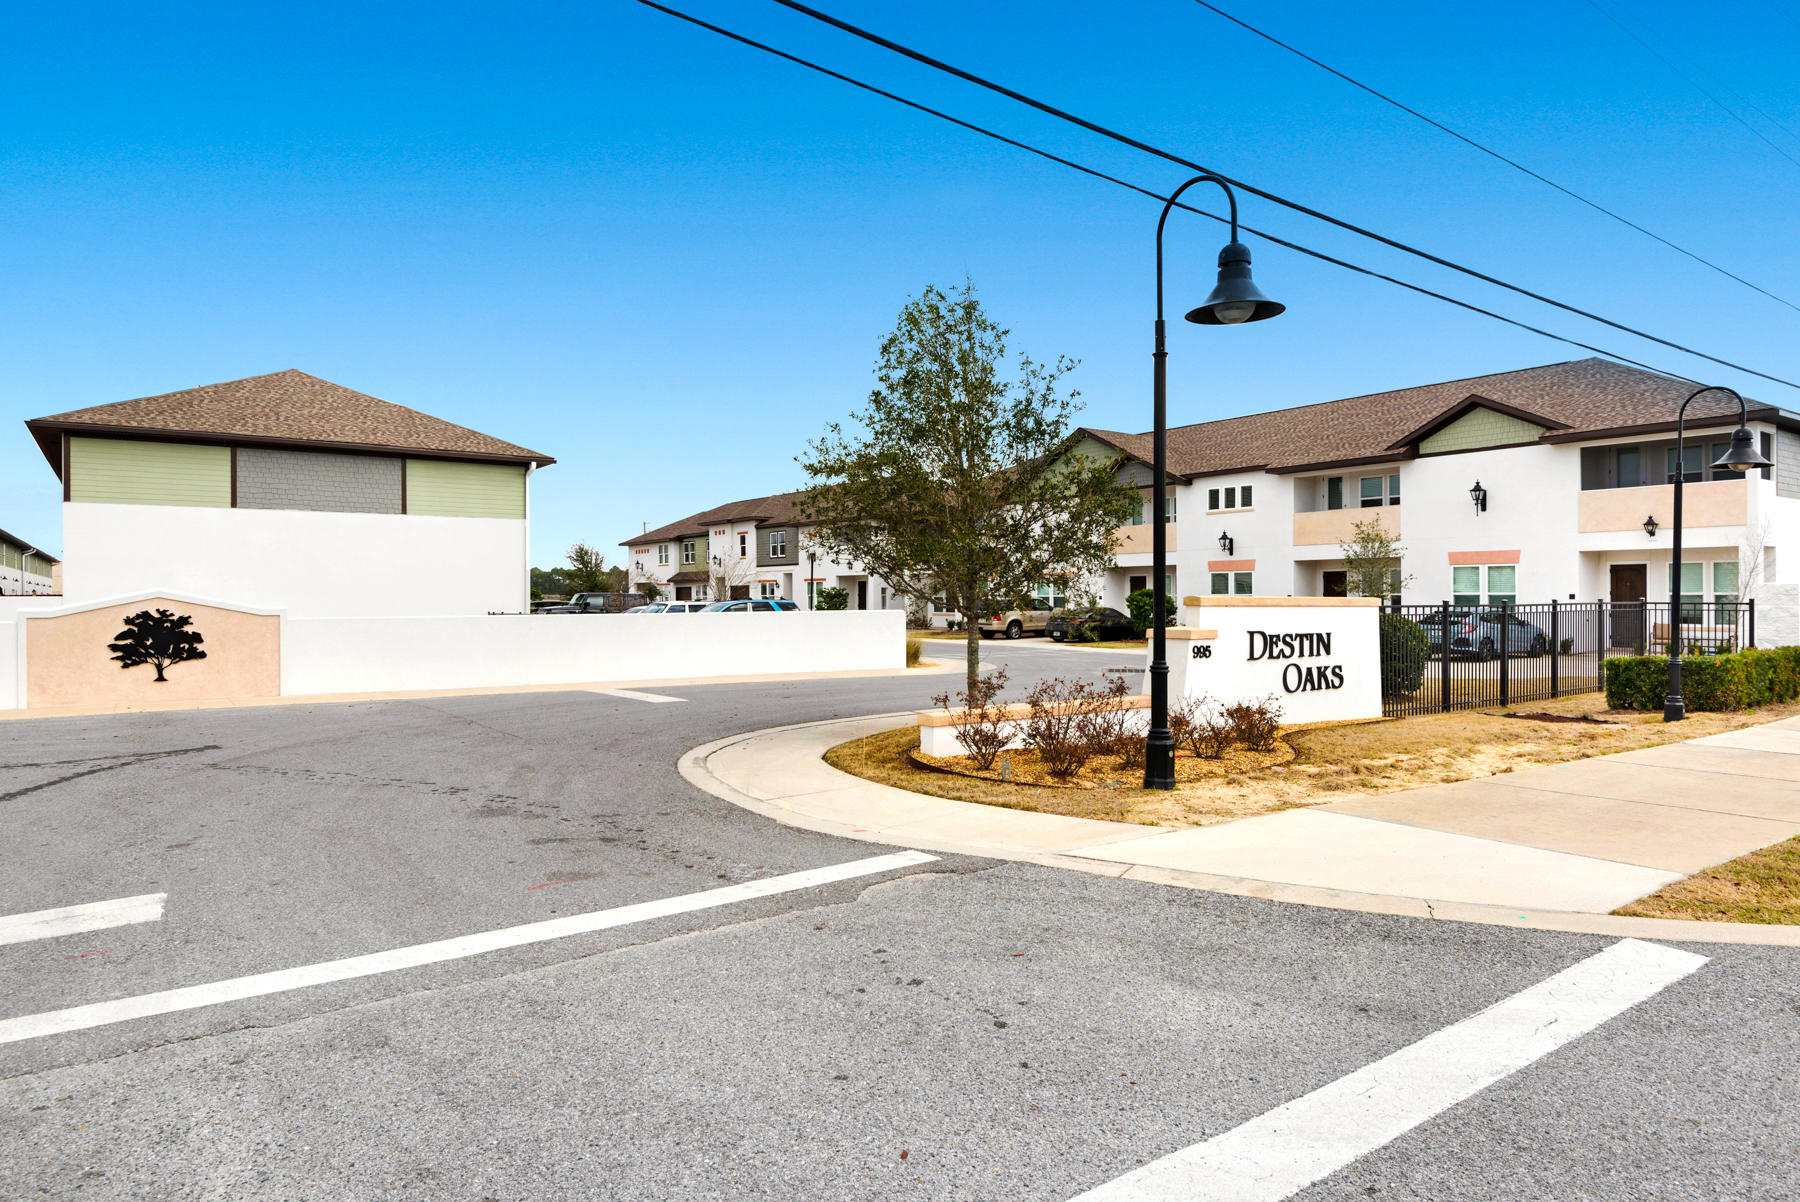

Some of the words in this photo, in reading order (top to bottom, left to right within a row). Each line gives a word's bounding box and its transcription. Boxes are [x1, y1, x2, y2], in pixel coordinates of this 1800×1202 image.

[1192, 645, 1212, 659] 995
[1247, 630, 1332, 661] DESTIN
[1282, 663, 1344, 694] OAKS
